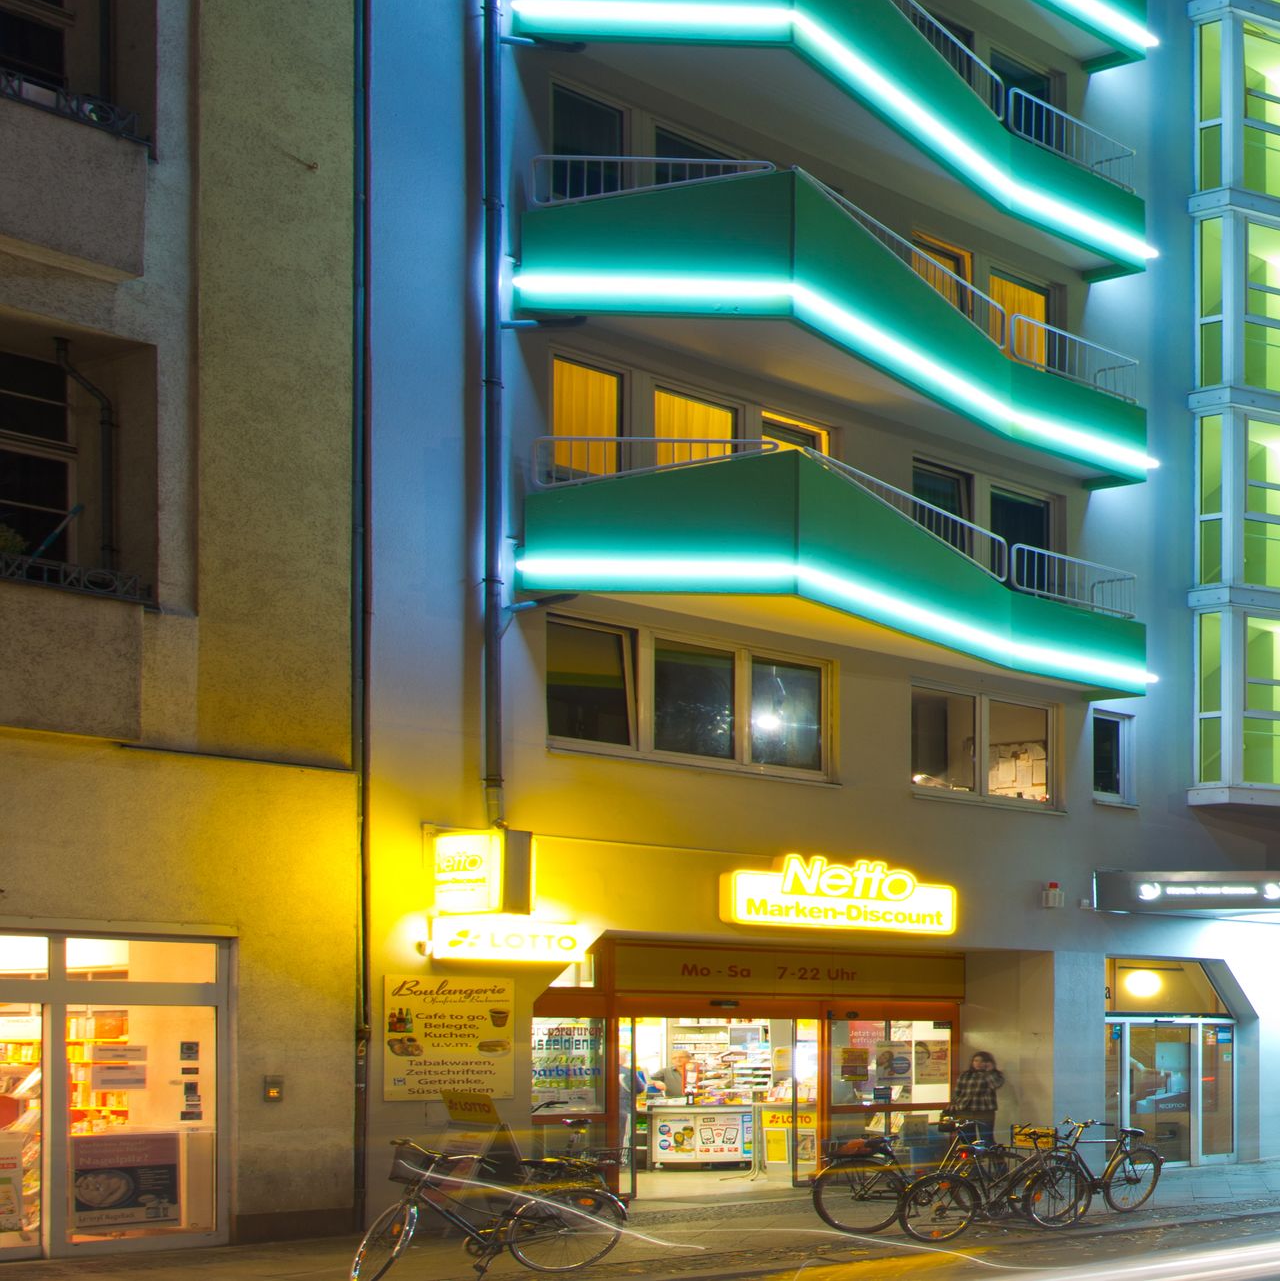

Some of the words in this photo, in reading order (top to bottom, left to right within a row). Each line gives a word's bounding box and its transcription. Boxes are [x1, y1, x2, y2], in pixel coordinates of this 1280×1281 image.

[780, 855, 917, 901] Netto
[745, 897, 944, 926] Marken-Discount
[490, 932, 577, 951] LOTTO
[681, 962, 711, 978] Mo
[727, 964, 751, 979] Sa
[827, 967, 857, 982] Uhr
[392, 979, 506, 1000] Boulangerie
[415, 1012, 447, 1021] Café
[449, 1013, 464, 1021] to
[466, 1014, 488, 1022] go,
[424, 1022, 480, 1031] Belegte,
[424, 1031, 480, 1039] Kuchen,
[407, 1059, 495, 1068] Tabakwaren,
[405, 1068, 497, 1077] Zeitschriften,
[417, 1077, 485, 1086] Getränke,
[460, 1102, 491, 1114] LOTTO
